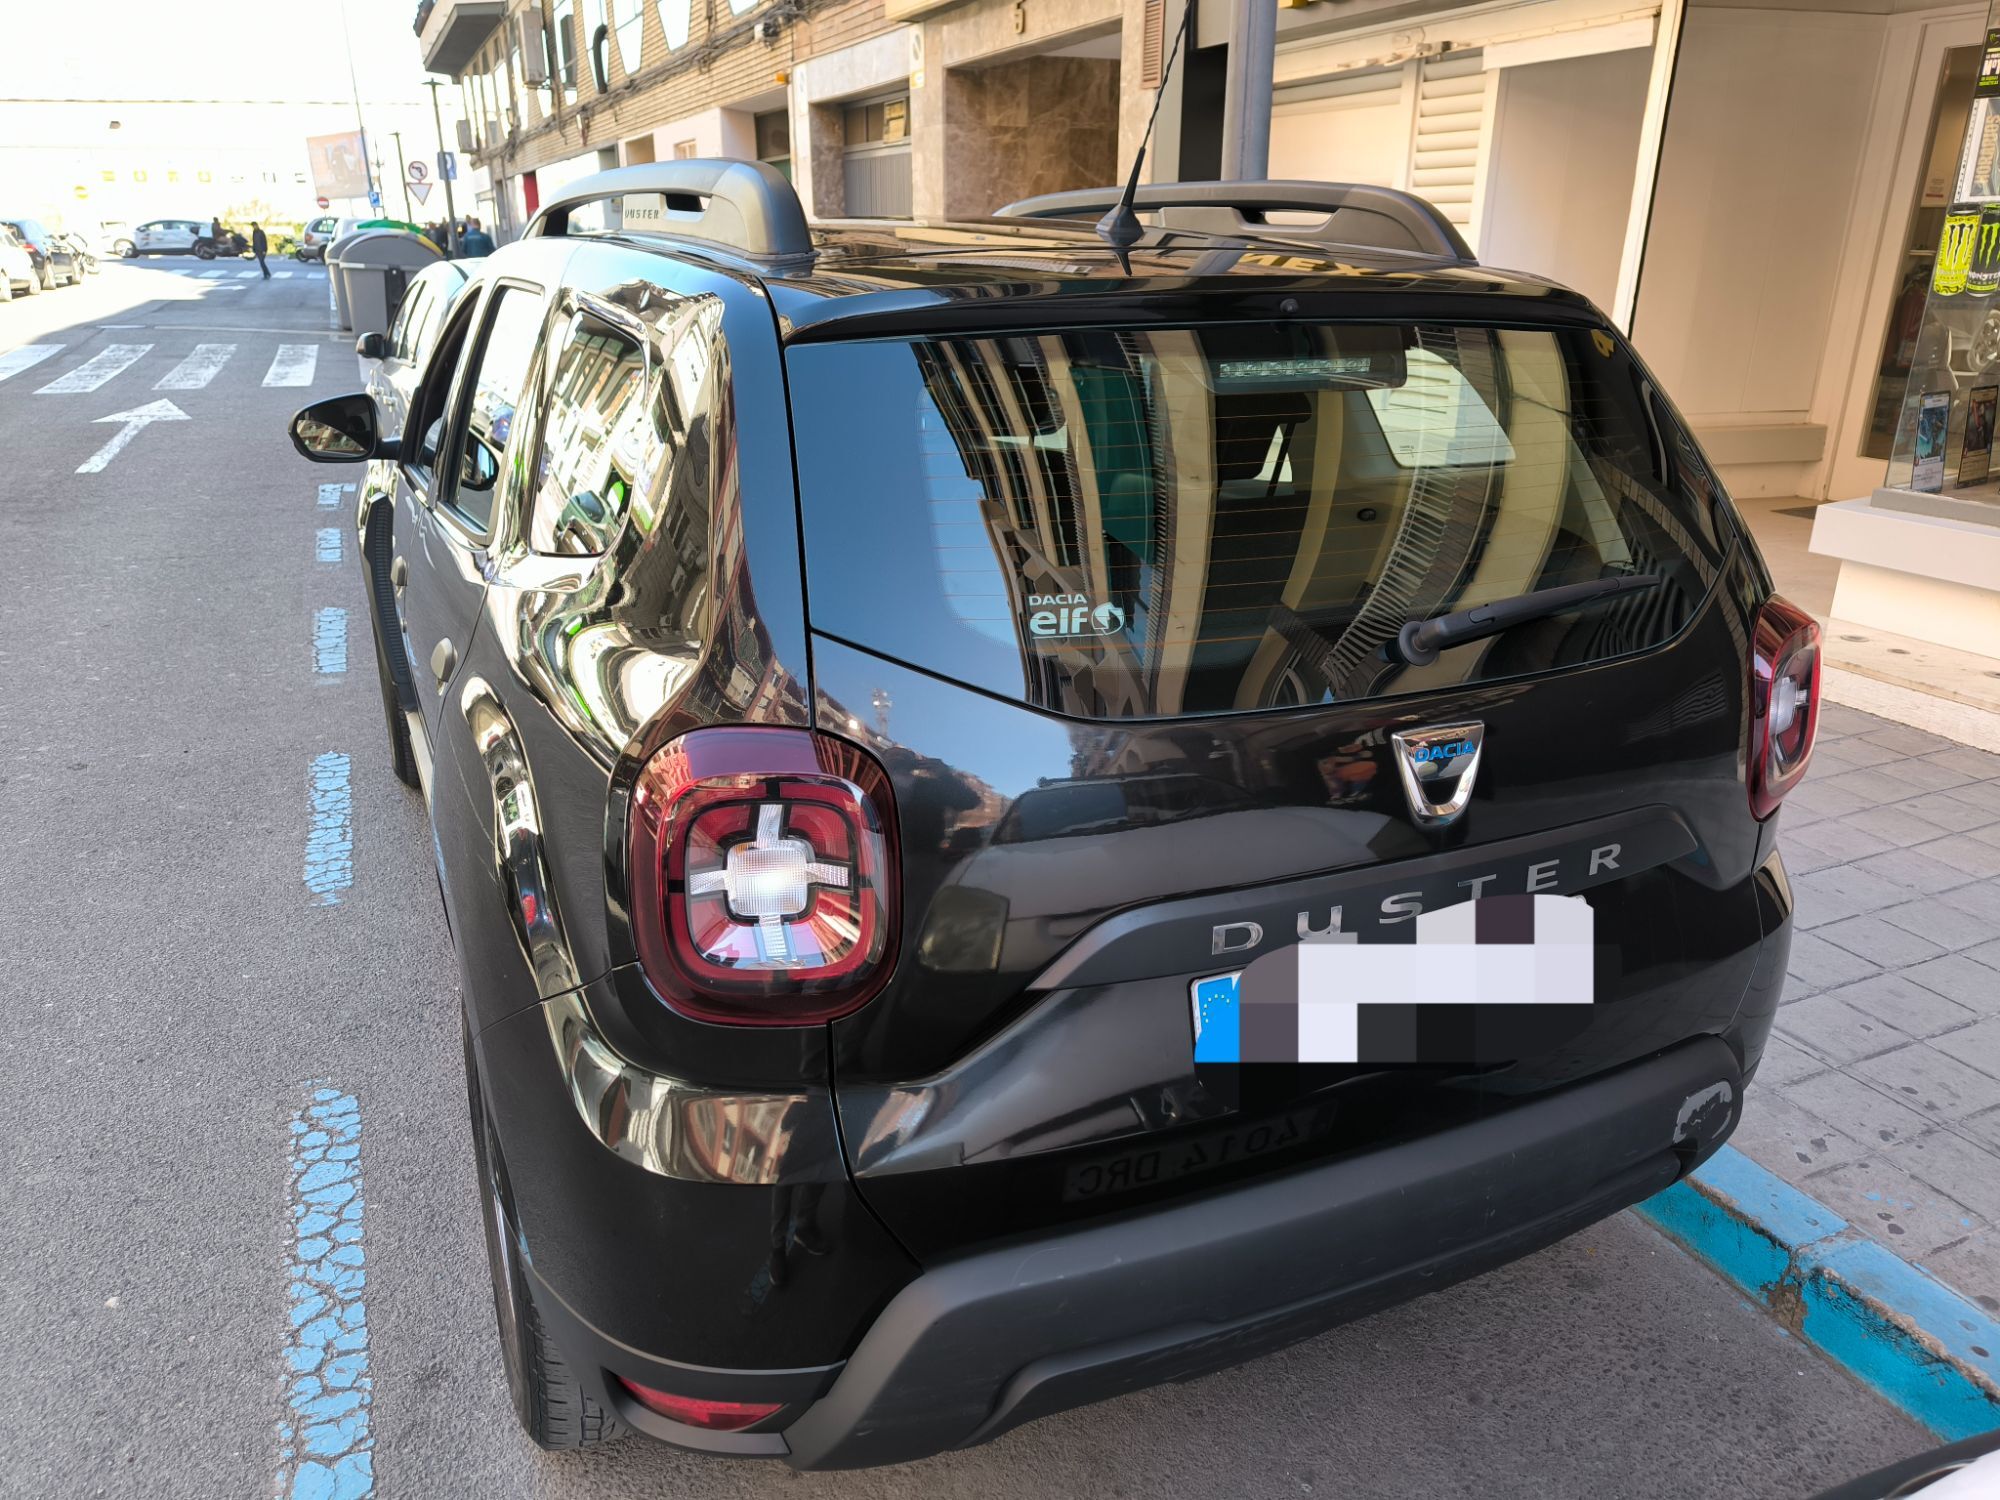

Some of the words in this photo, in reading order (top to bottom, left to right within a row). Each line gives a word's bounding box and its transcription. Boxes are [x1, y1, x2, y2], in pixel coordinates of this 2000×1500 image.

[1014, 1, 1026, 34] 5
[625, 209, 659, 219] DUSTER
[1028, 593, 1088, 606] DACIA
[1029, 606, 1089, 635] elf
[1414, 740, 1475, 763] DACIA
[1211, 843, 1622, 956] DUSTER
